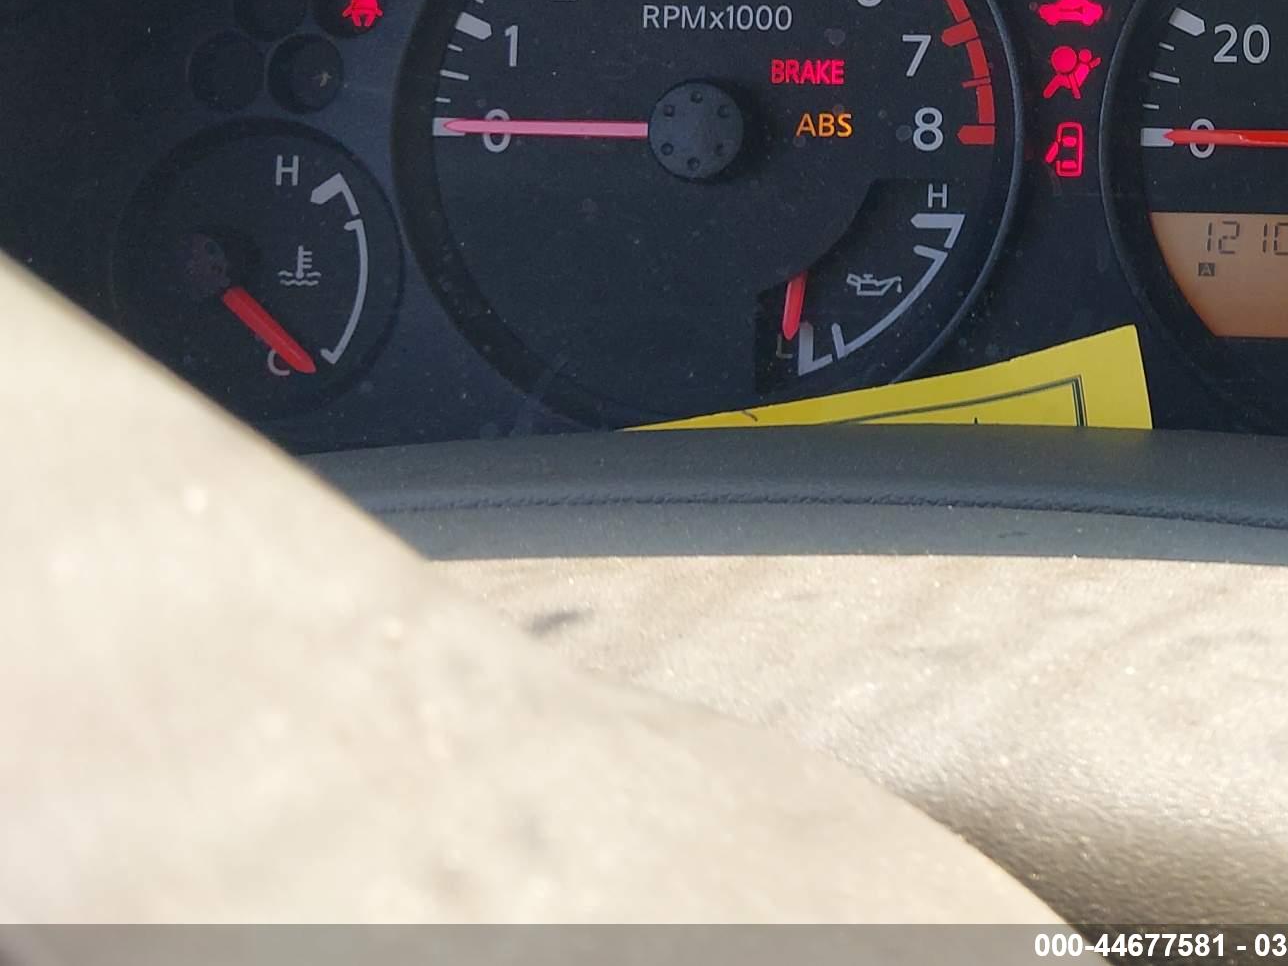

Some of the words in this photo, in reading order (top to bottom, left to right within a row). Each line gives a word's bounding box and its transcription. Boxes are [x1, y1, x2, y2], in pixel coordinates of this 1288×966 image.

[643, 4, 792, 31] RPMx1000
[504, 25, 519, 67] 1
[902, 34, 932, 77] 7
[1213, 23, 1270, 64] 20
[771, 59, 845, 85] BRAKE
[482, 109, 510, 152] 0
[796, 113, 852, 137] ABS
[912, 107, 944, 151] 8
[1189, 119, 1215, 158] 0
[275, 155, 299, 186] H
[927, 183, 948, 208] H
